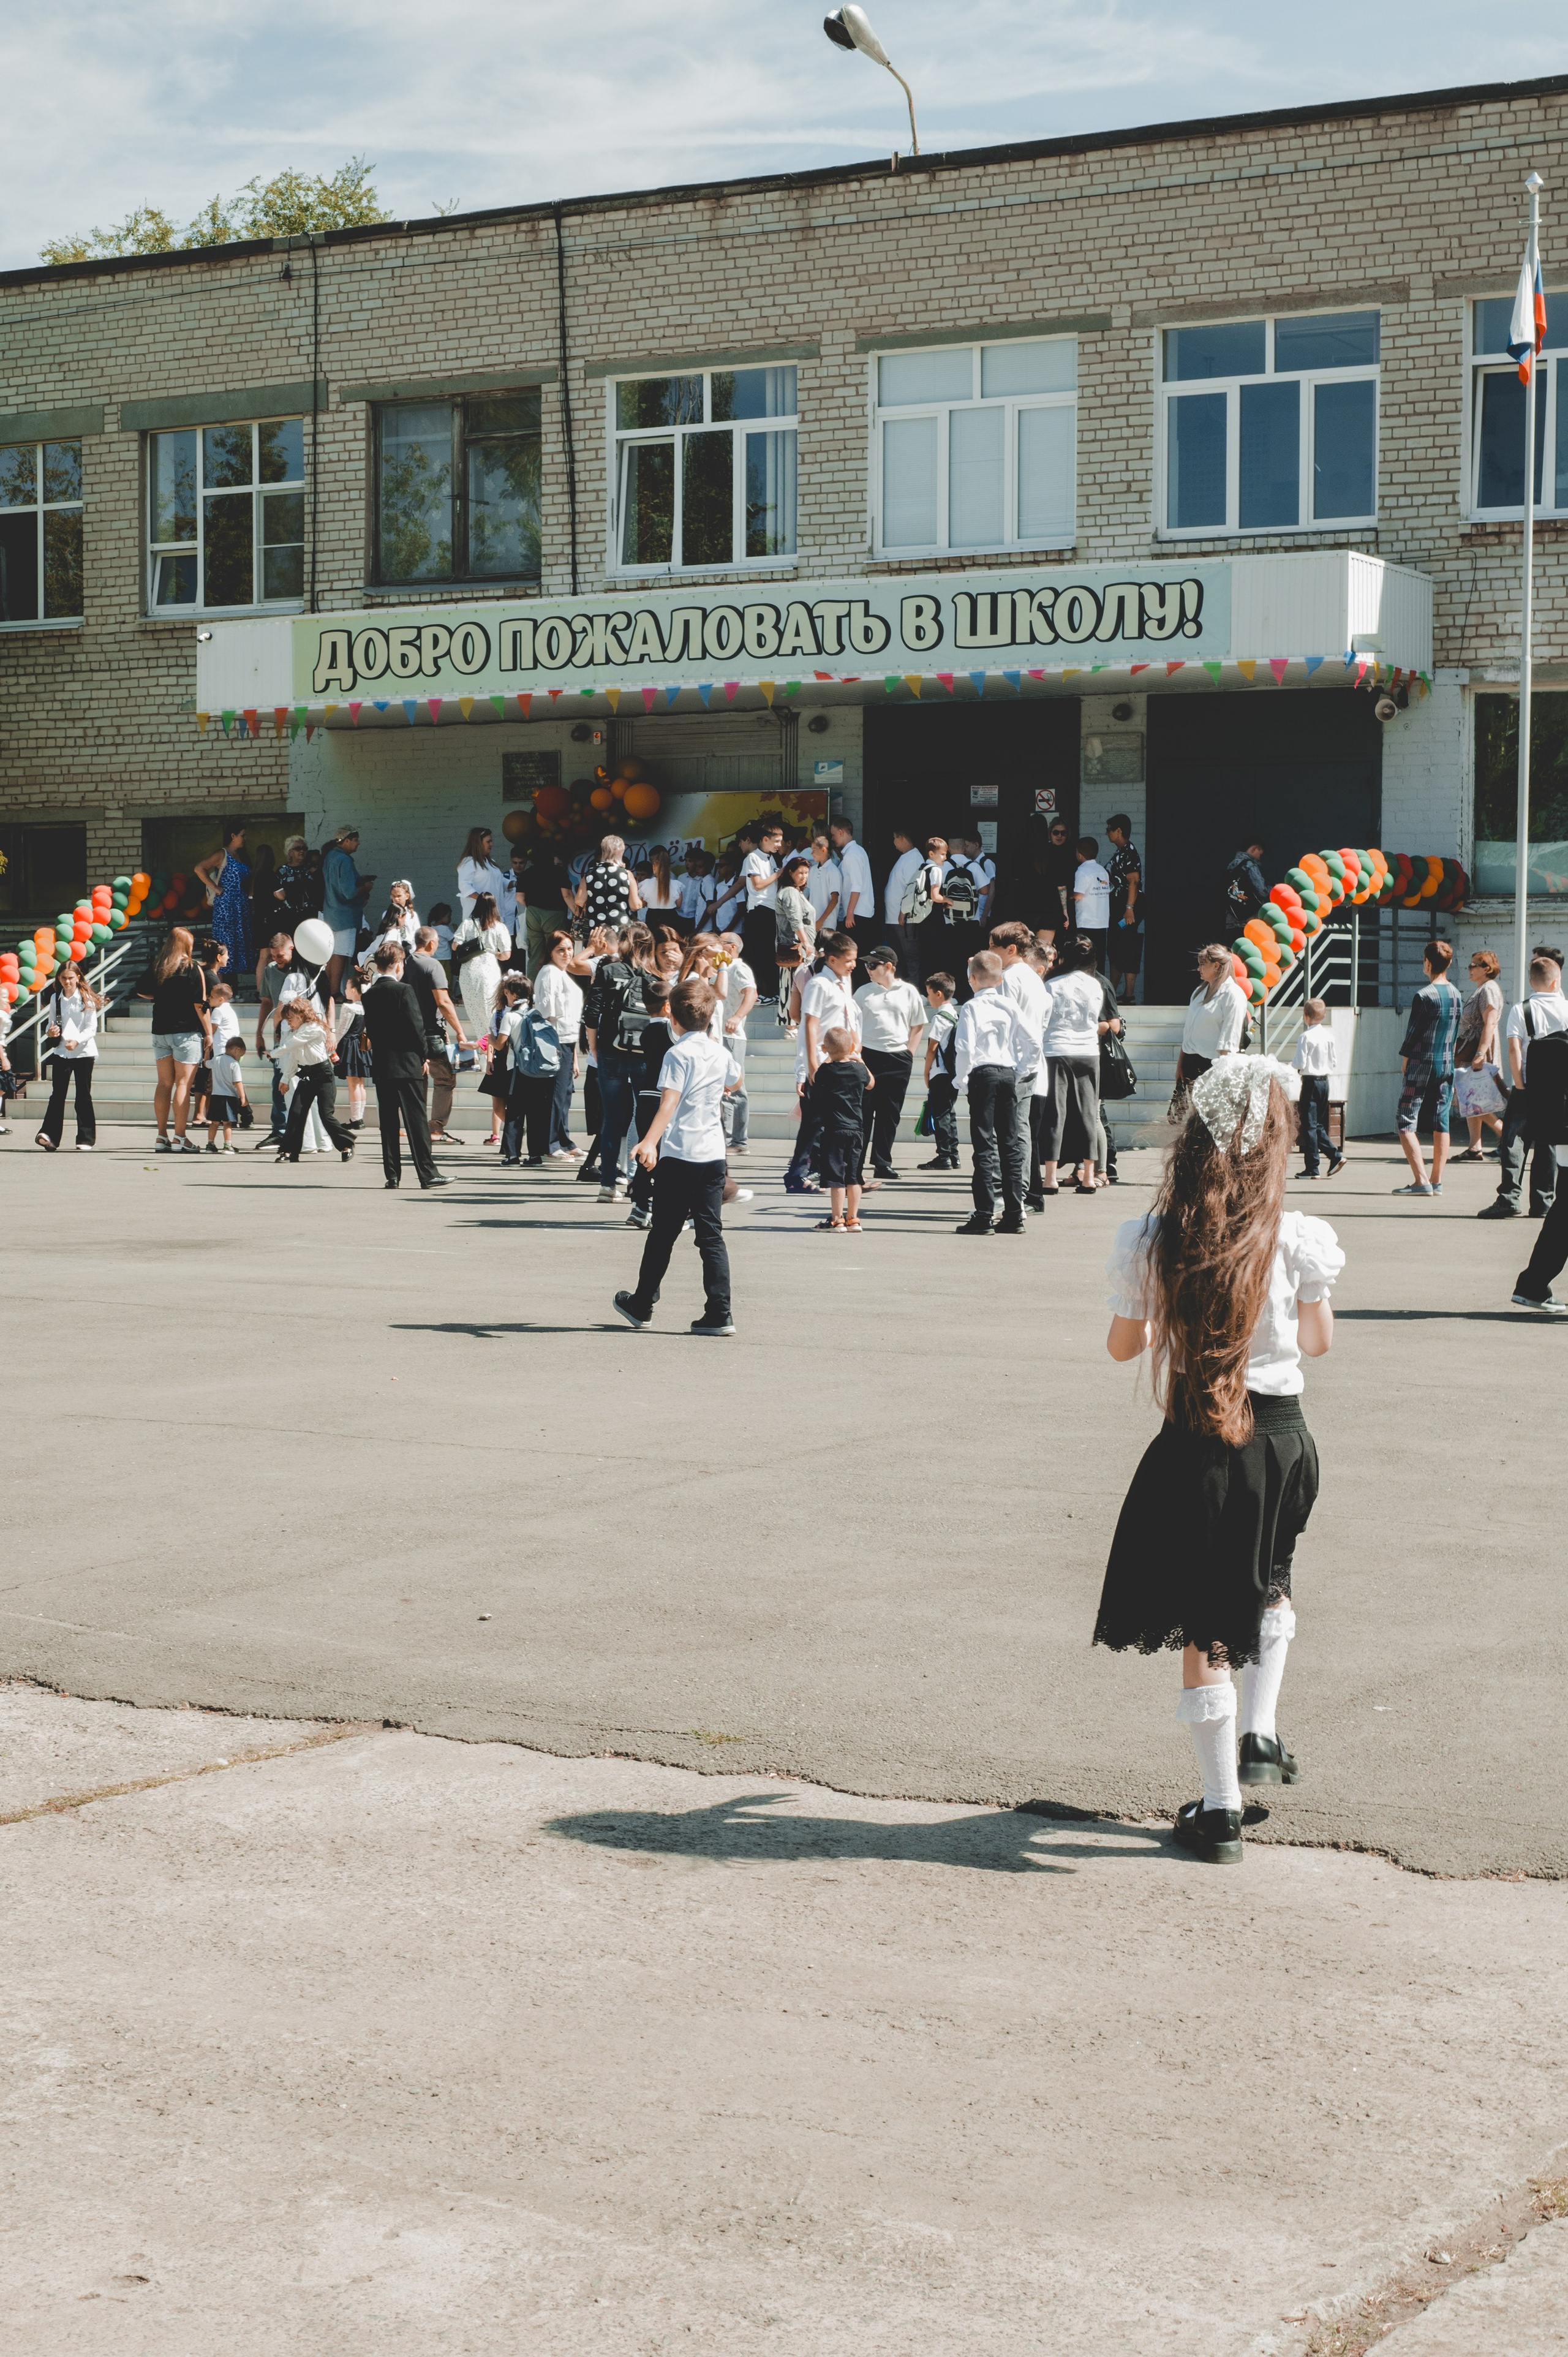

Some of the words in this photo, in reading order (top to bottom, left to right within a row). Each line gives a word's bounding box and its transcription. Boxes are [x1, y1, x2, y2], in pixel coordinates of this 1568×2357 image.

[313, 621, 491, 693] ДОБРО
[499, 600, 891, 671] ПОЖАЛОВАТЬ
[900, 595, 944, 652] В
[952, 578, 1204, 649] ШКОЛУ!
